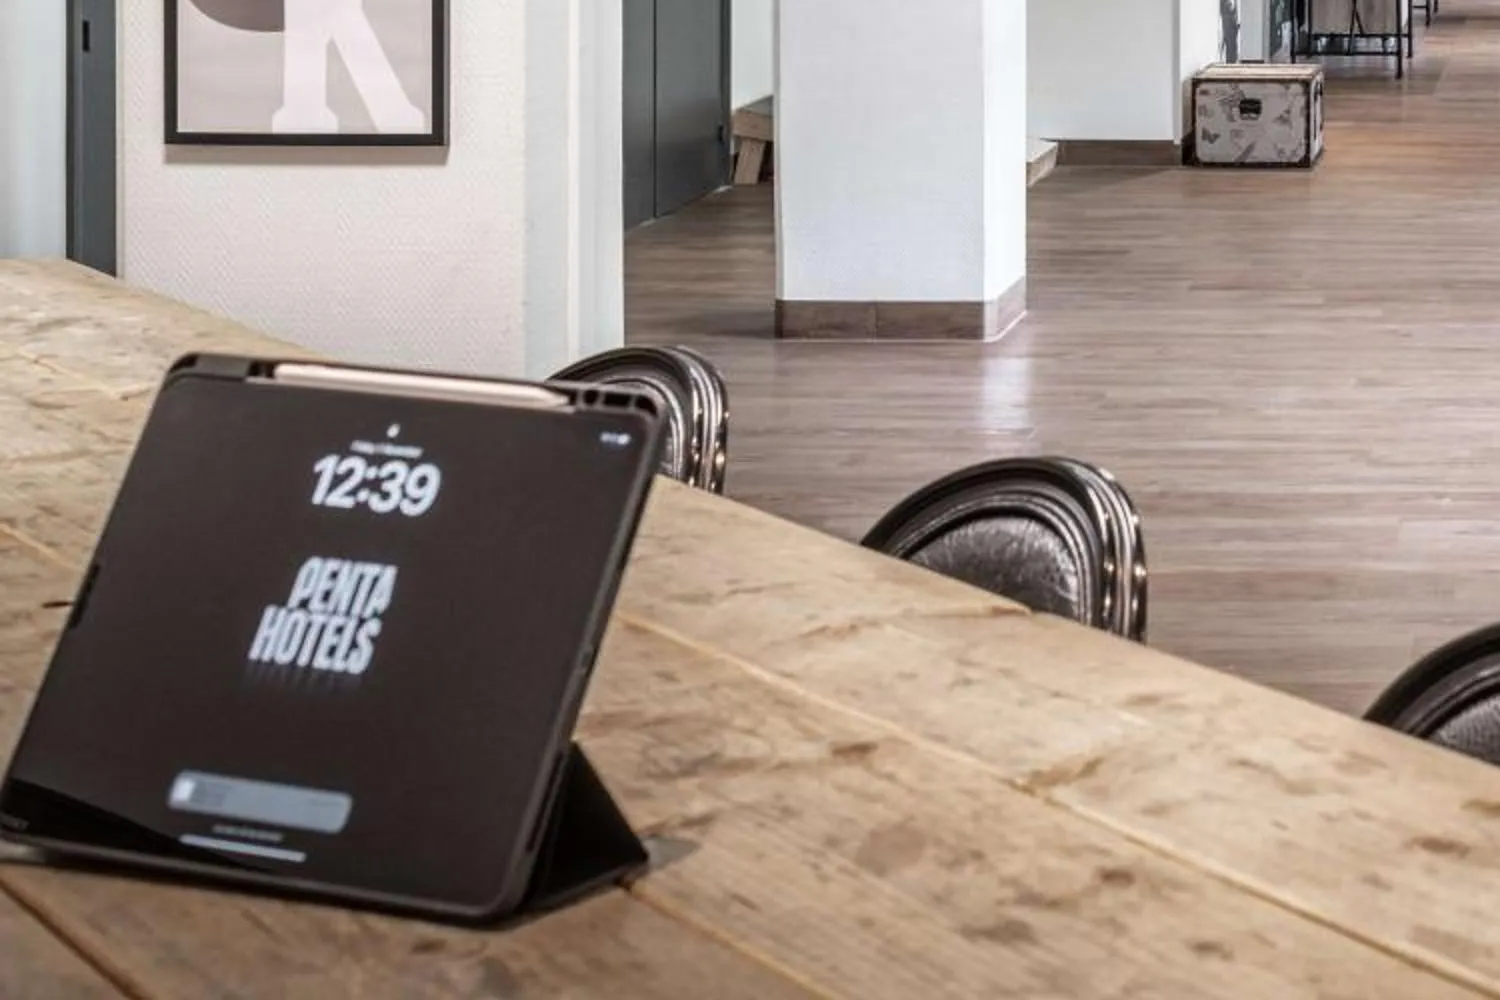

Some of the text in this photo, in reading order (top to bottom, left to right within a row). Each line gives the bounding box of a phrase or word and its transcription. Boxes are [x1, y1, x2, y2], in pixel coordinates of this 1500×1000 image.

[311, 454, 441, 517] 12:39
[286, 556, 399, 619] PENTA
[249, 604, 383, 675] HOTELS
